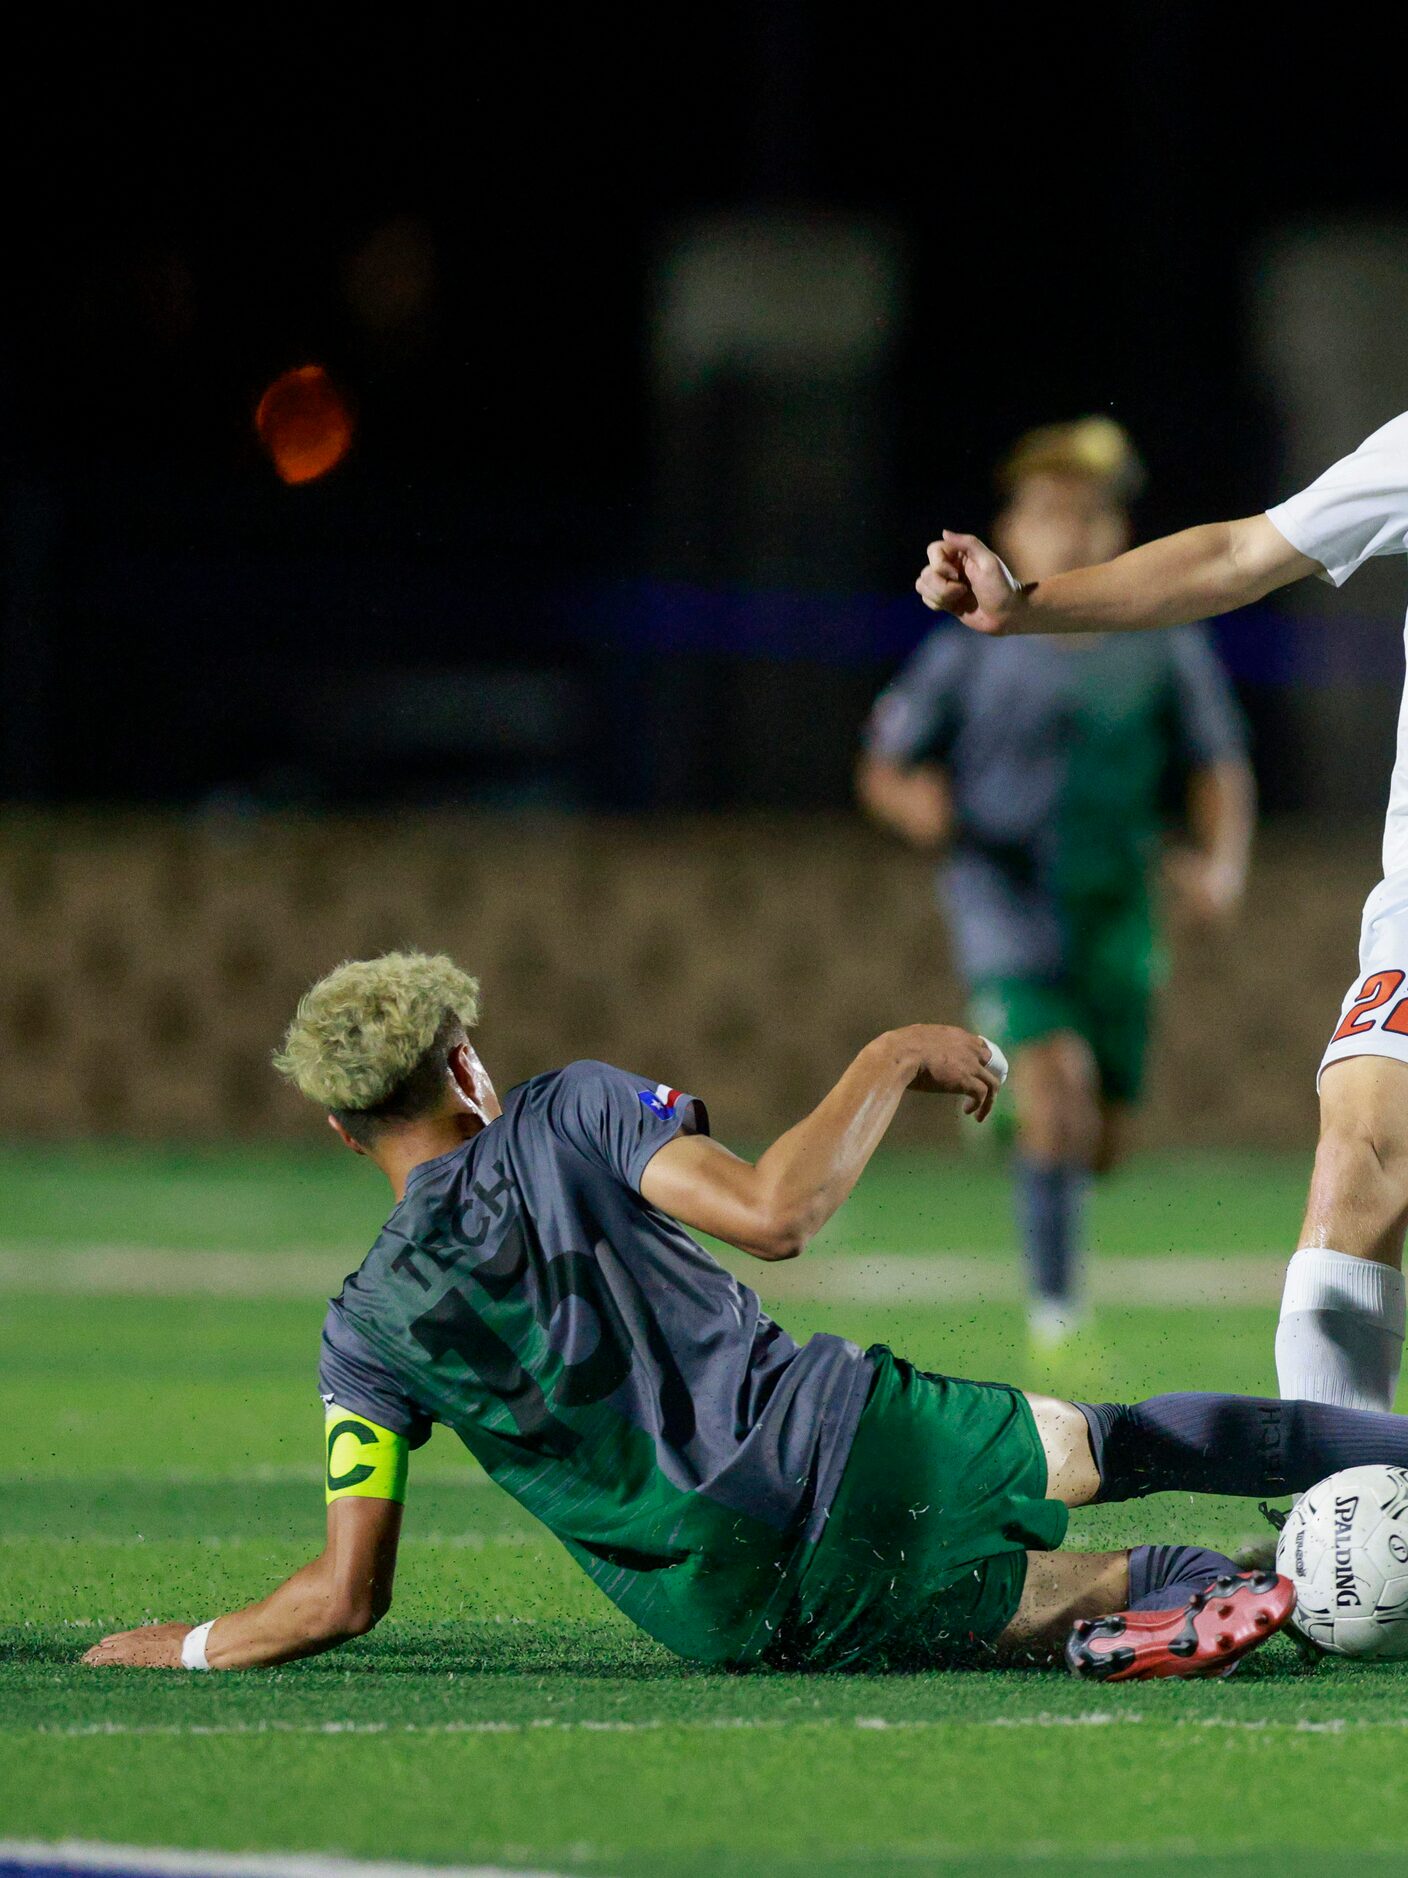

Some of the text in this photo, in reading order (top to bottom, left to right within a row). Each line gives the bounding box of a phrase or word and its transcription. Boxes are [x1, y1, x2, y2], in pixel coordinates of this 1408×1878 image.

[390, 1159, 516, 1293] TECH
[327, 1419, 380, 1492] C
[1334, 1495, 1362, 1608] SPALDING
